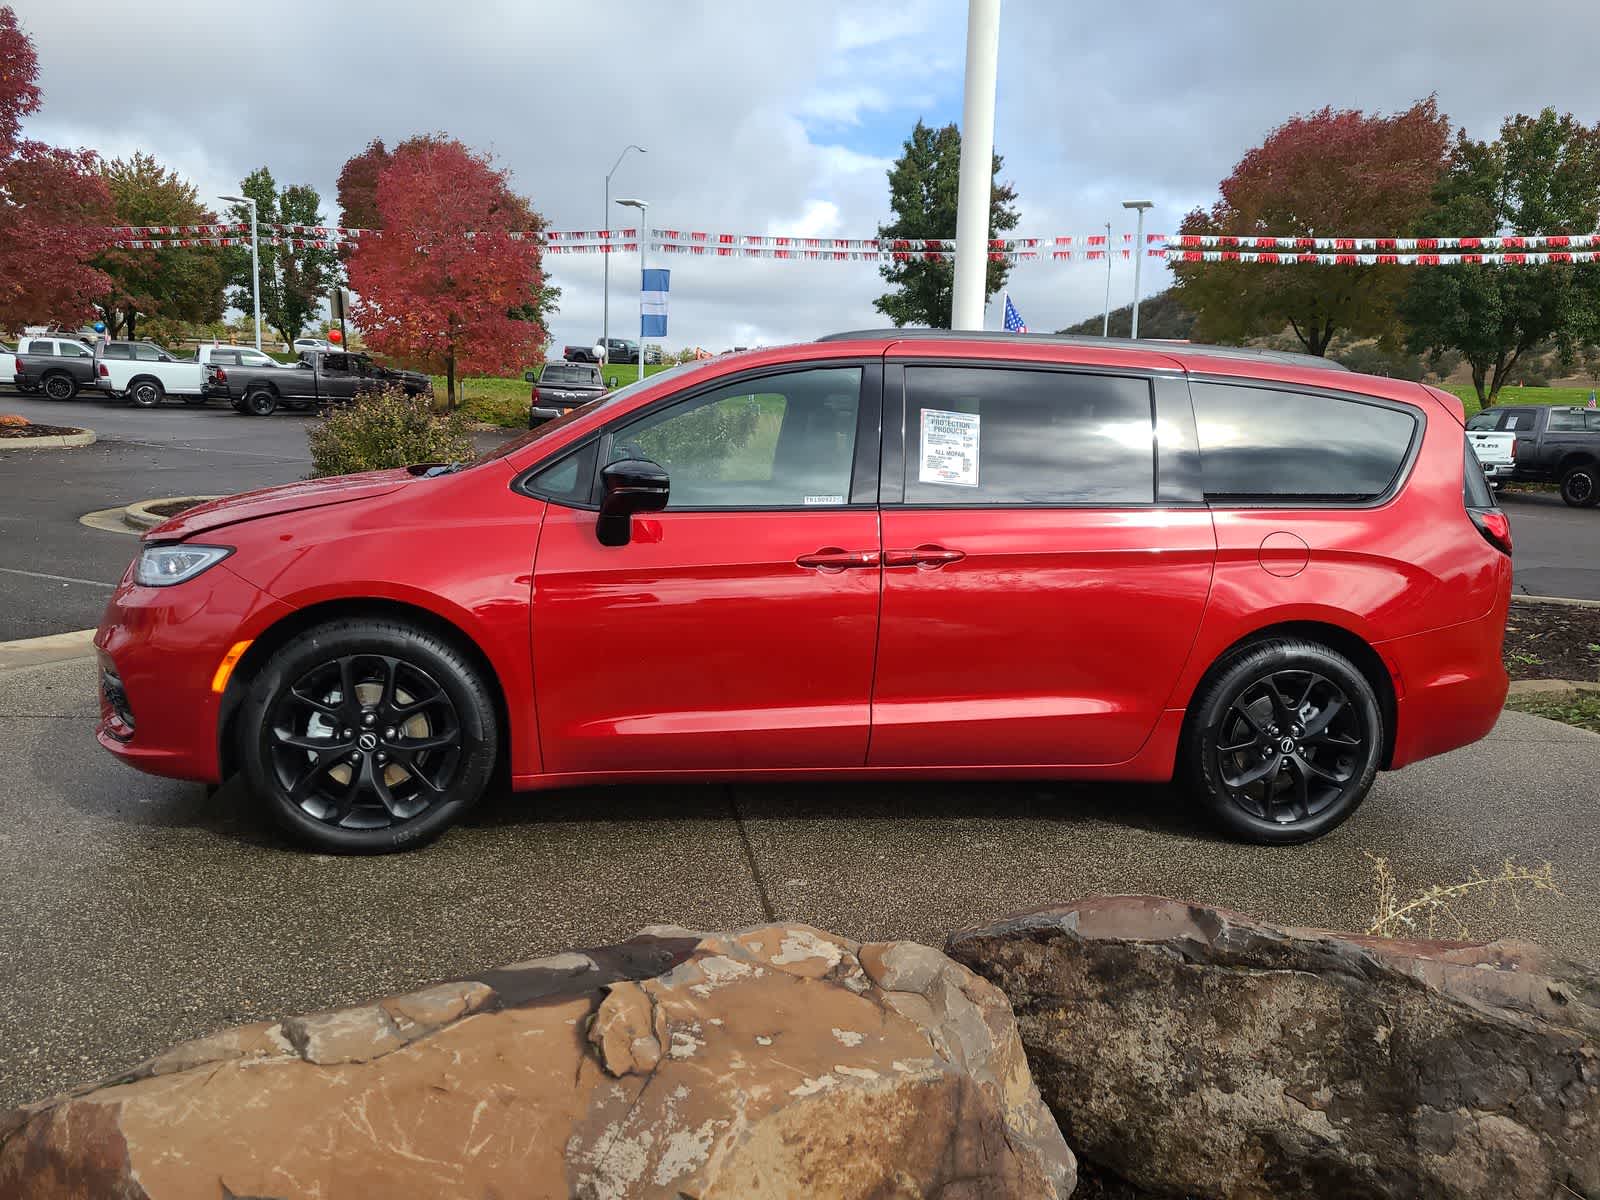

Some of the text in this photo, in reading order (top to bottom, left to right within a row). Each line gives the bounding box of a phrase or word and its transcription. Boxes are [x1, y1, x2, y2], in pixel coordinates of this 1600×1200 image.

[931, 419, 970, 429] PROTECTION
[934, 425, 967, 435] PRODUCTS
[946, 450, 965, 458] MOPAR
